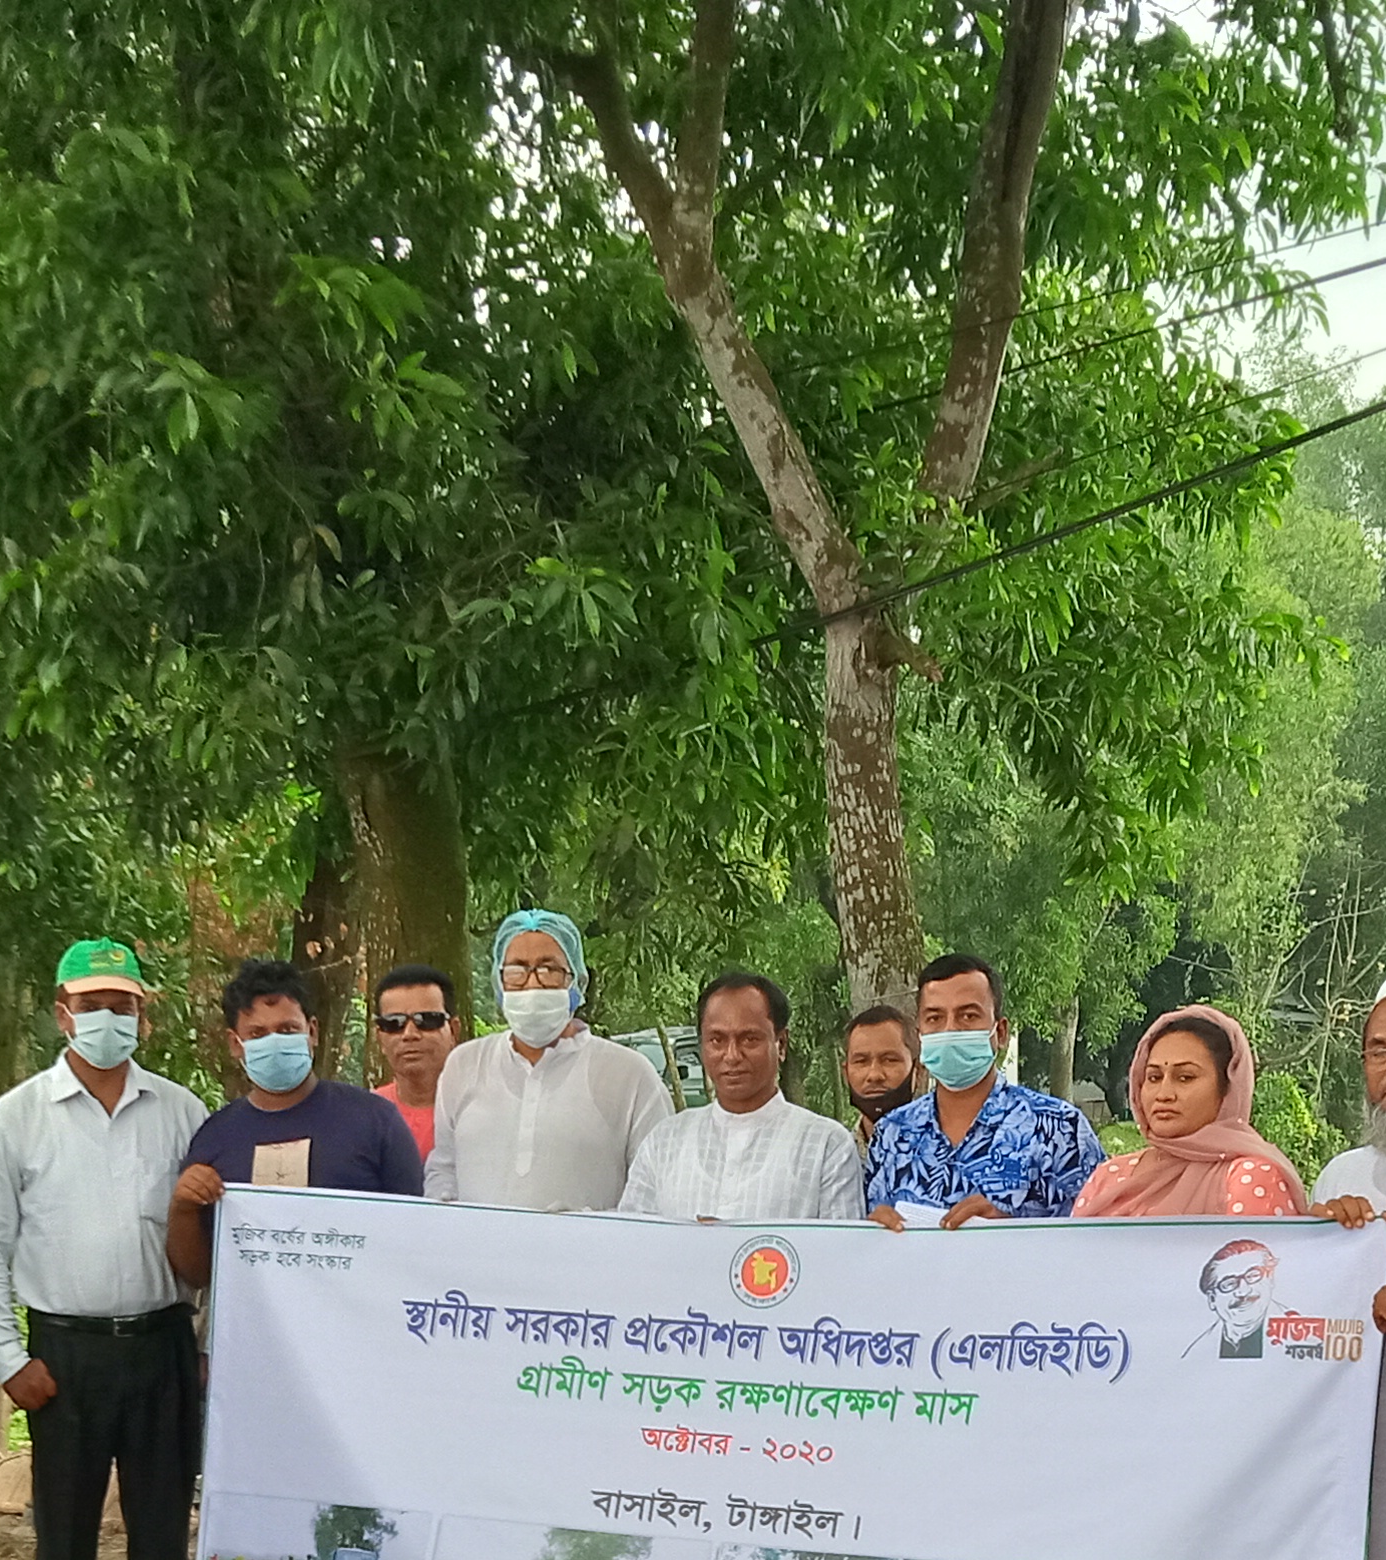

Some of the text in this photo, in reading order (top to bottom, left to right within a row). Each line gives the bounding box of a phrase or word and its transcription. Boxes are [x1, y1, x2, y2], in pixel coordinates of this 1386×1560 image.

[270, 1226, 307, 1245] বর্ষের
[312, 1228, 367, 1249] অঙ্গীকার
[239, 1249, 353, 1270] সড়ক হবে সংস্কার
[403, 1289, 1132, 1382] স্থানীয় সরকার প্রকৌশল অধিদপ্তর (এলজিইডি)
[1266, 1310, 1325, 1345] মুজিব
[1327, 1319, 1364, 1335] MUJIB
[1285, 1343, 1323, 1359] শতবর্ষ
[1325, 1335, 1363, 1362] 100
[518, 1355, 978, 1425] গ্রামীণ সড়ক রক্ষণাবেক্ষণ মাস
[641, 1424, 732, 1456] অক্টোবর
[762, 1437, 833, 1465] ২০২০
[592, 1489, 712, 1533] বাসাইল,
[727, 1494, 844, 1540] টাঙ্গাইল
